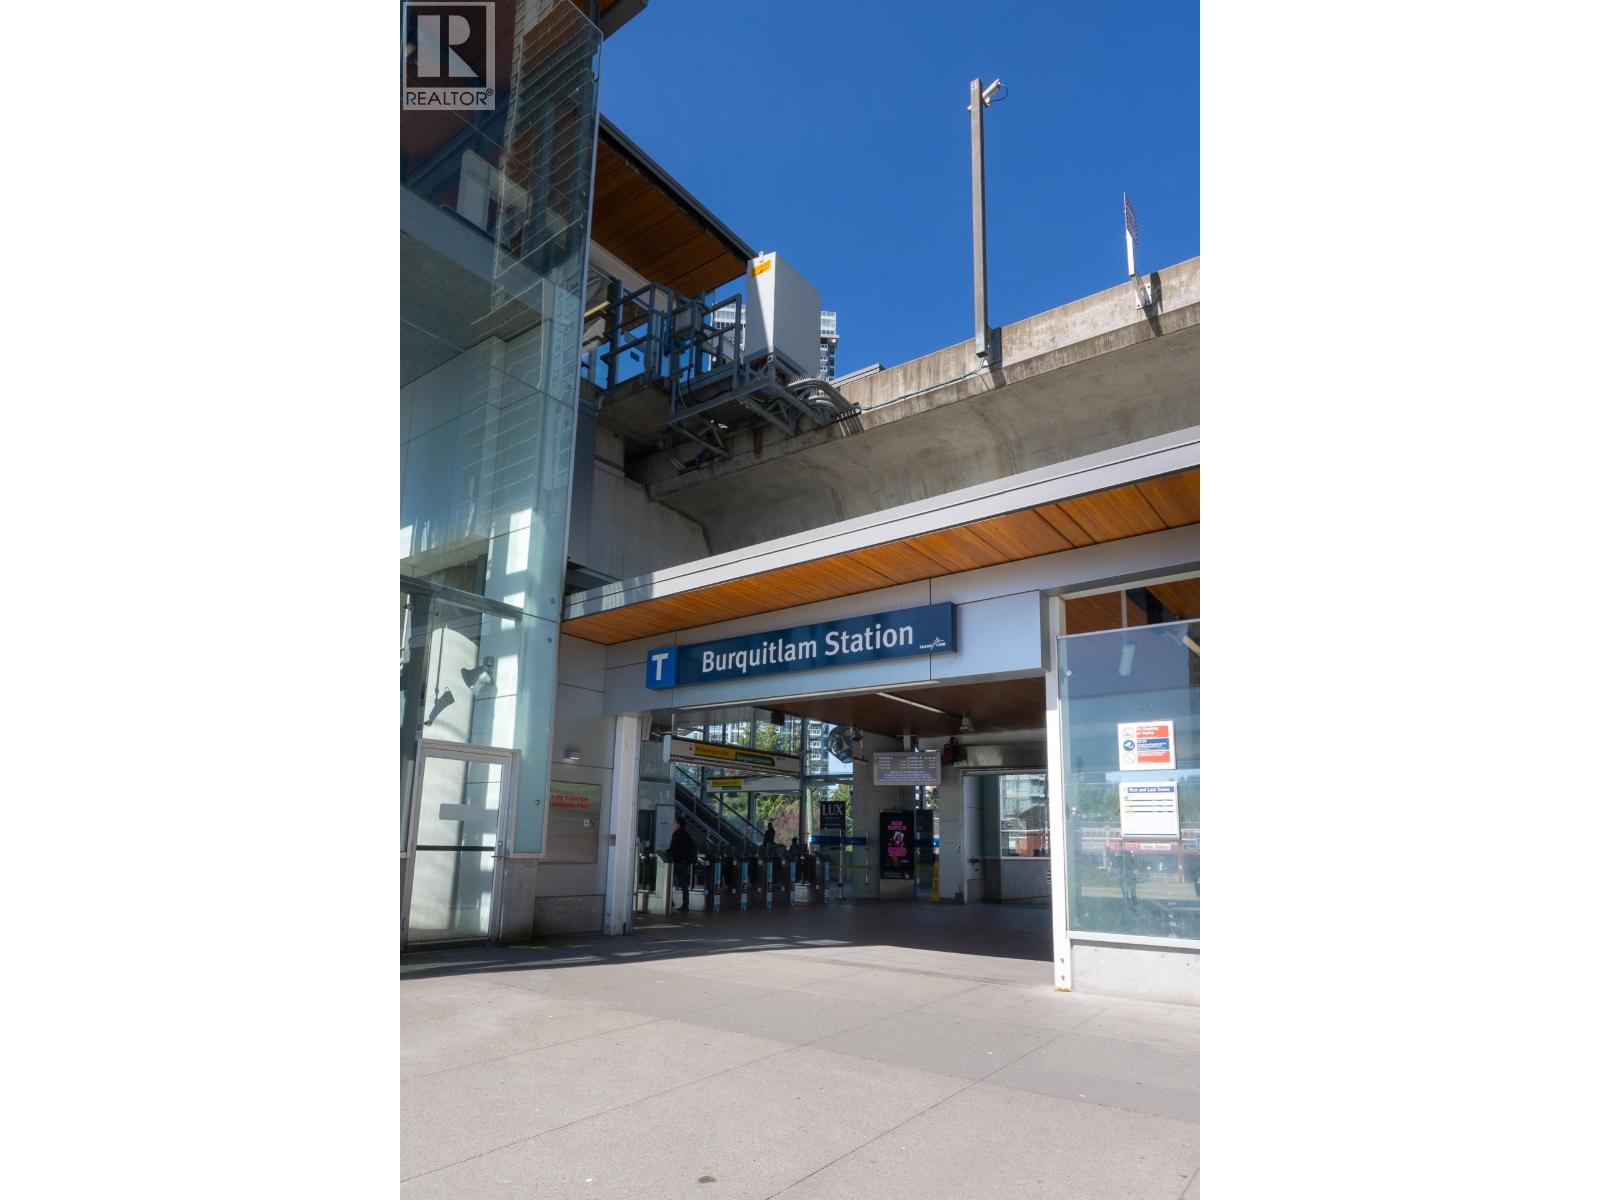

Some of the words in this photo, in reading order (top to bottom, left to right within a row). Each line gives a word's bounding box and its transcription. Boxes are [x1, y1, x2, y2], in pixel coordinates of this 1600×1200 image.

[702, 639, 817, 674] Burquitlam
[824, 623, 914, 656] Station
[651, 652, 669, 681] T
[822, 804, 843, 816] LUX
